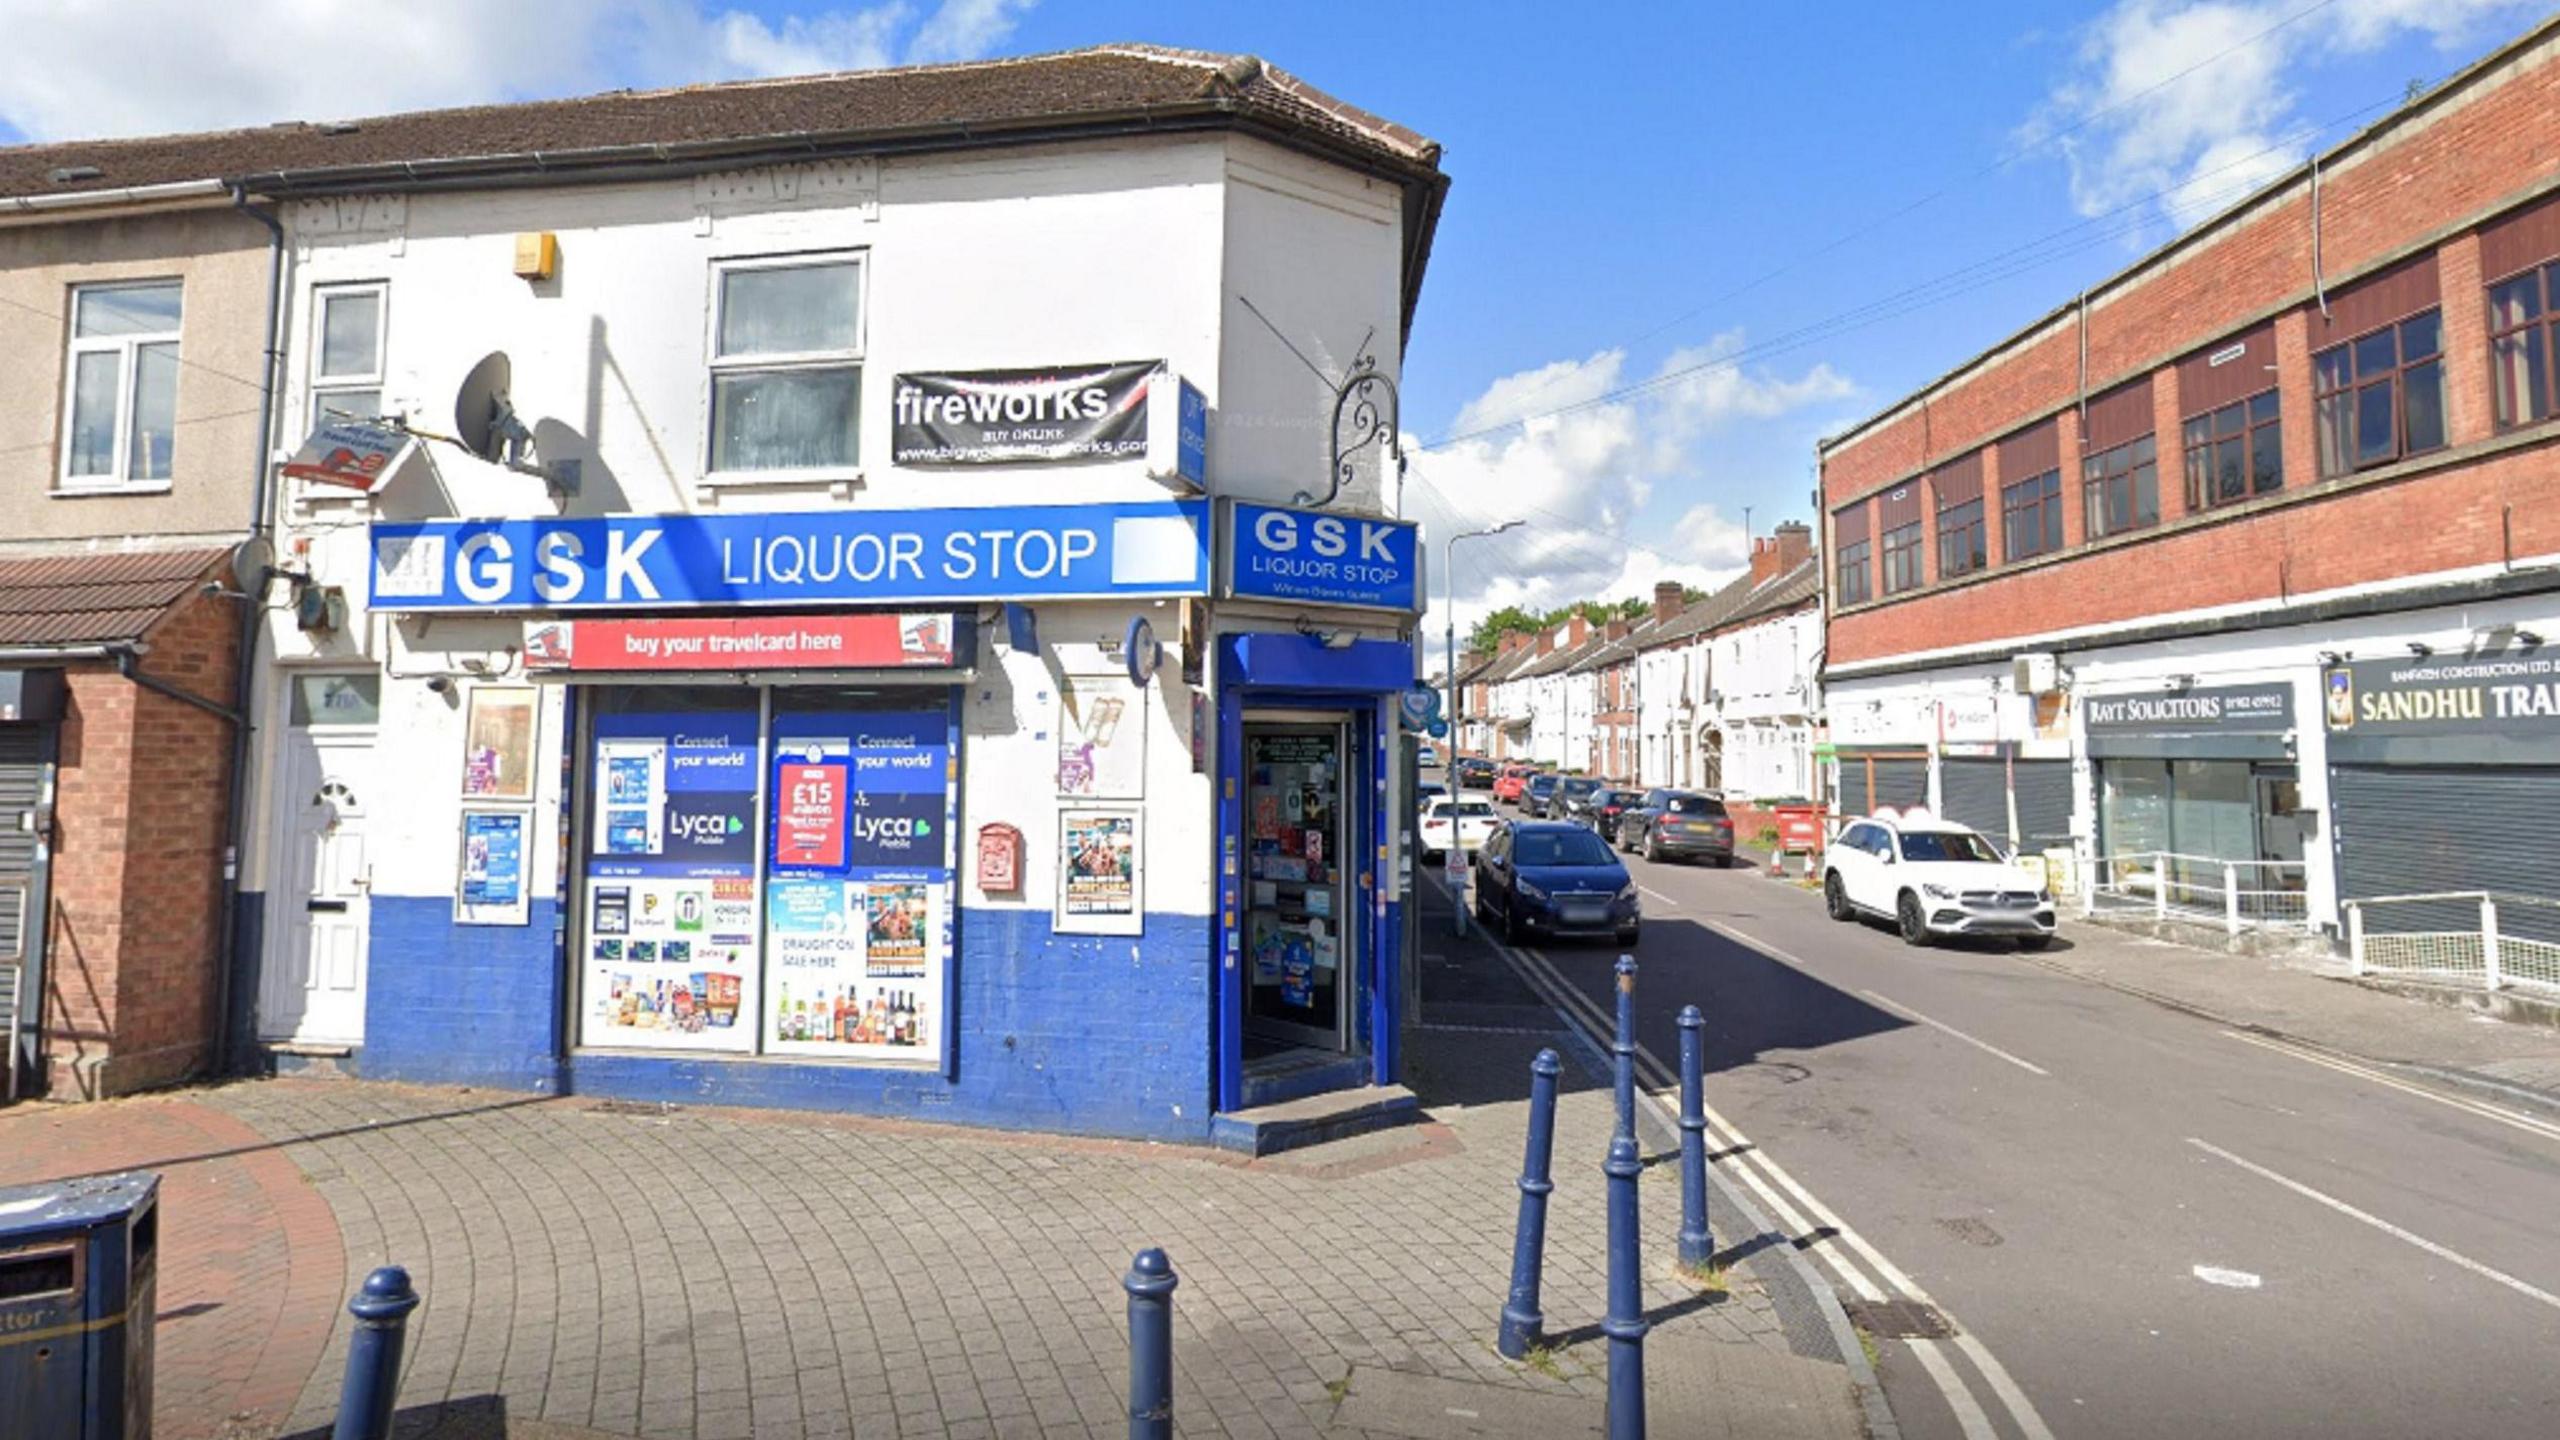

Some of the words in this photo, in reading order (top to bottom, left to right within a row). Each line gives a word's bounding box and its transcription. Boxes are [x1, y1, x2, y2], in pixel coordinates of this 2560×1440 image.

[896, 385, 1109, 425] fireworks
[723, 532, 924, 584] LIQUOR
[943, 529, 1097, 580] STOP
[1252, 555, 1337, 580] LIQUOR
[1343, 565, 1398, 584] STOP
[625, 633, 659, 655] buy
[663, 636, 704, 656] your
[709, 632, 796, 654] travelcard
[800, 632, 842, 650] here
[2441, 662, 2528, 680] CONSTRUCTION
[2529, 661, 2550, 674] LTD
[2090, 701, 2126, 723] RAYT
[2361, 687, 2482, 721] SANDHU
[673, 735, 729, 749] Connect
[858, 735, 916, 749] Connect
[673, 754, 703, 769] your
[706, 752, 744, 767] world
[856, 754, 888, 769] your
[891, 752, 931, 768] world
[793, 783, 832, 804] £15
[671, 811, 726, 838] Lyca
[854, 812, 912, 839] Lyca
